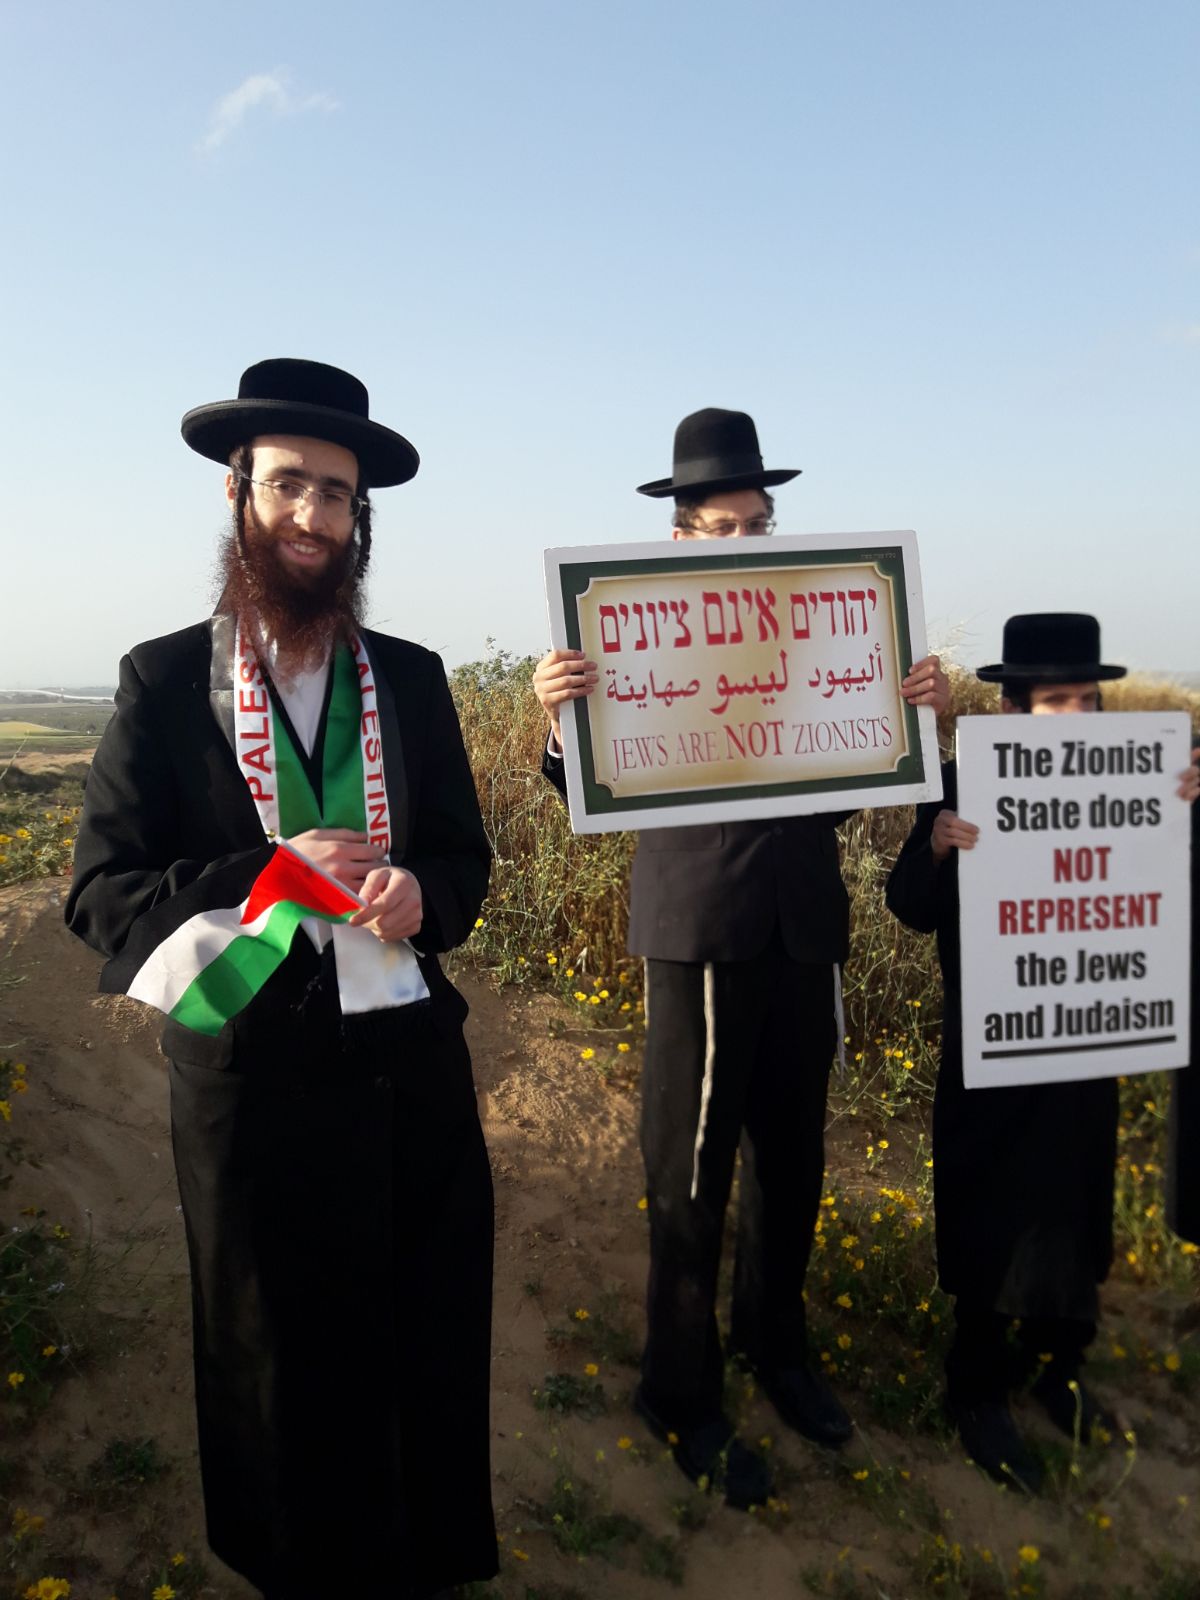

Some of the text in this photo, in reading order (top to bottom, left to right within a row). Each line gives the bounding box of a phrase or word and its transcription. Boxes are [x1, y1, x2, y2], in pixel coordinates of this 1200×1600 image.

[599, 587, 877, 653] יהודים אינם ציונים
[606, 668, 701, 709] صهاينة
[709, 649, 788, 715] ليسو
[611, 716, 893, 781] JEWS ARE NOT ZIONISTS
[993, 740, 1164, 778] The Zionist
[996, 794, 1162, 833] State does
[1053, 846, 1112, 883] NOT
[998, 892, 1162, 936] REPRESENT
[1015, 948, 1147, 988] the Jews
[984, 998, 1174, 1043] and Judaism
